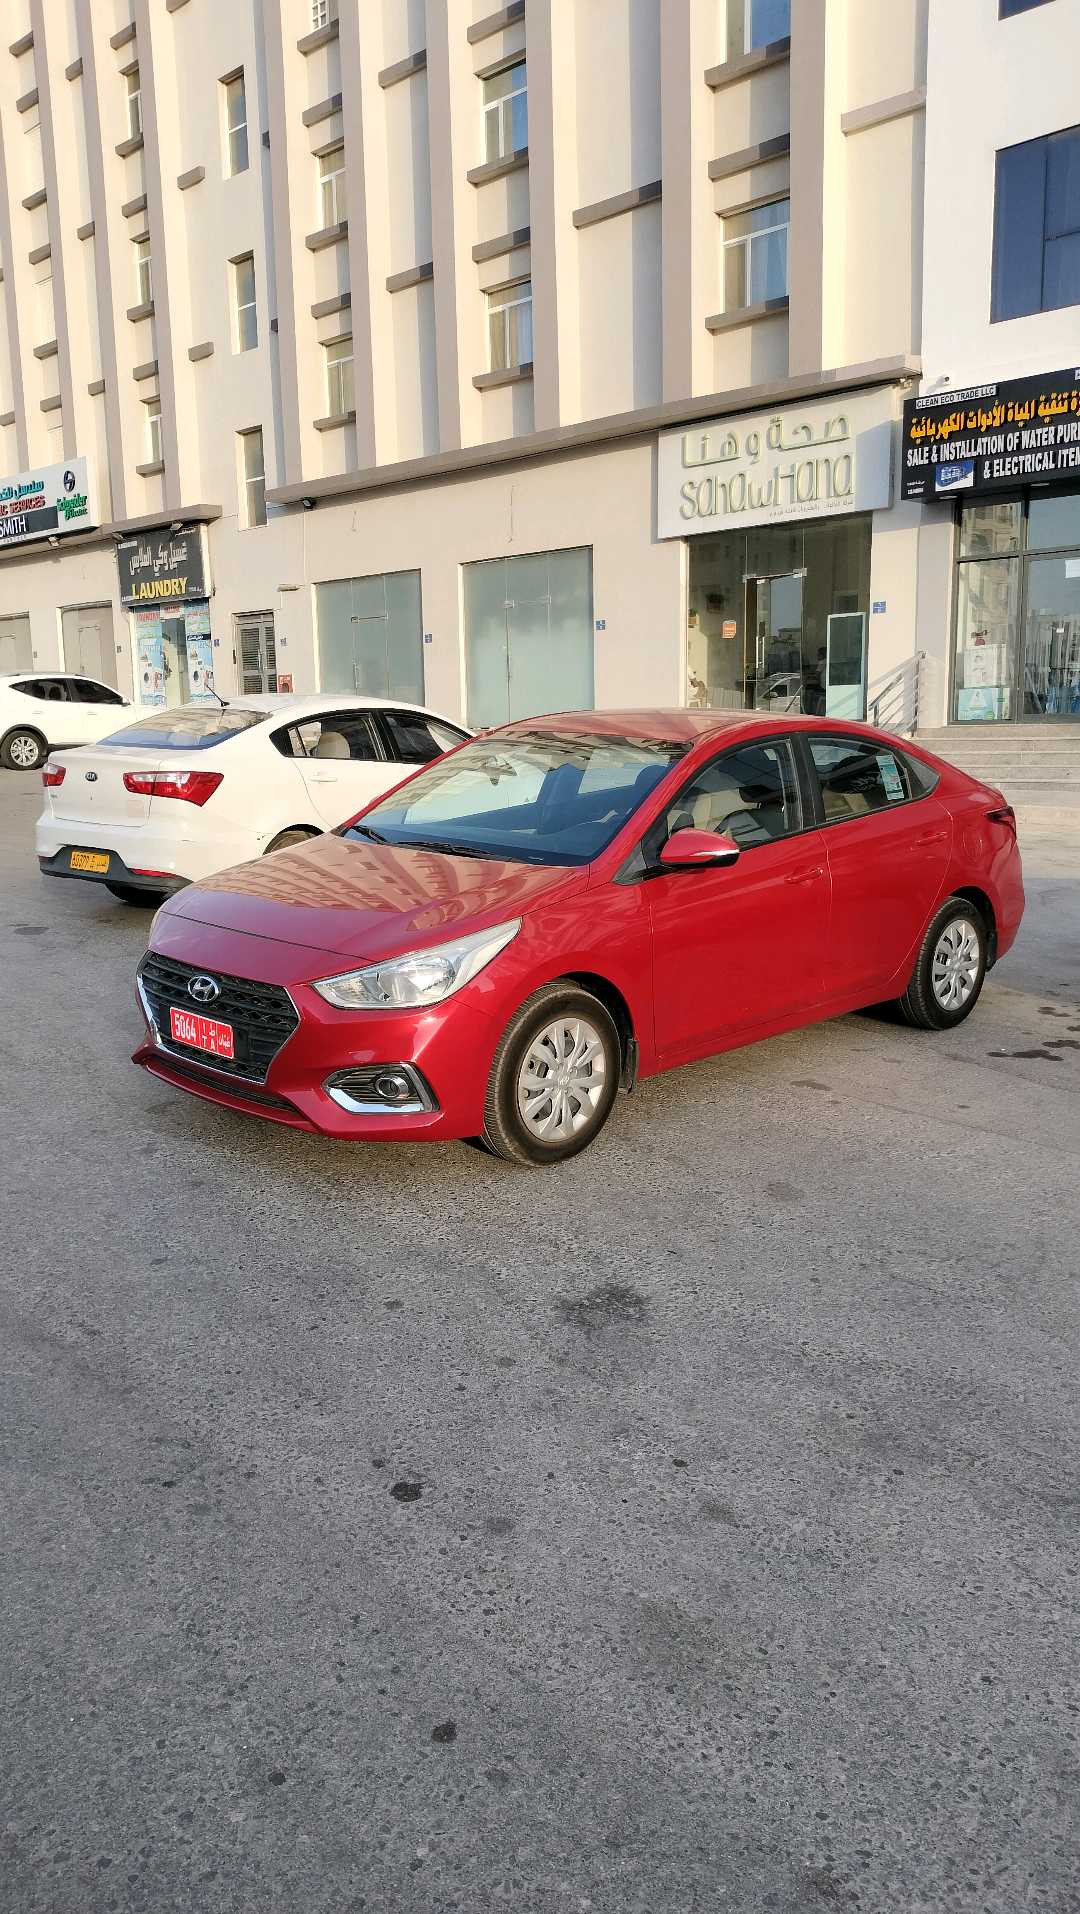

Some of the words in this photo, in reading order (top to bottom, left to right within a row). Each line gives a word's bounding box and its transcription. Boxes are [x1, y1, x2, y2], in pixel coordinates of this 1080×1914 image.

[916, 397, 939, 408] CLEAN
[940, 394, 955, 404] ECO
[957, 389, 979, 400] TRADE
[980, 386, 994, 397] LLC
[1037, 392, 1069, 424] تنقية
[910, 411, 965, 445] الكهربائية
[966, 399, 1005, 433] الأدوات
[906, 446, 930, 467] SALE
[931, 445, 938, 463] &
[940, 434, 1005, 461] INSTALLATION
[1006, 431, 1020, 452] OF
[1021, 426, 1055, 449] WATER
[983, 460, 991, 479] &
[993, 451, 1055, 478] ELECTRICAL
[131, 577, 188, 600] LAUNDRY
[174, 1013, 197, 1042] 5064
